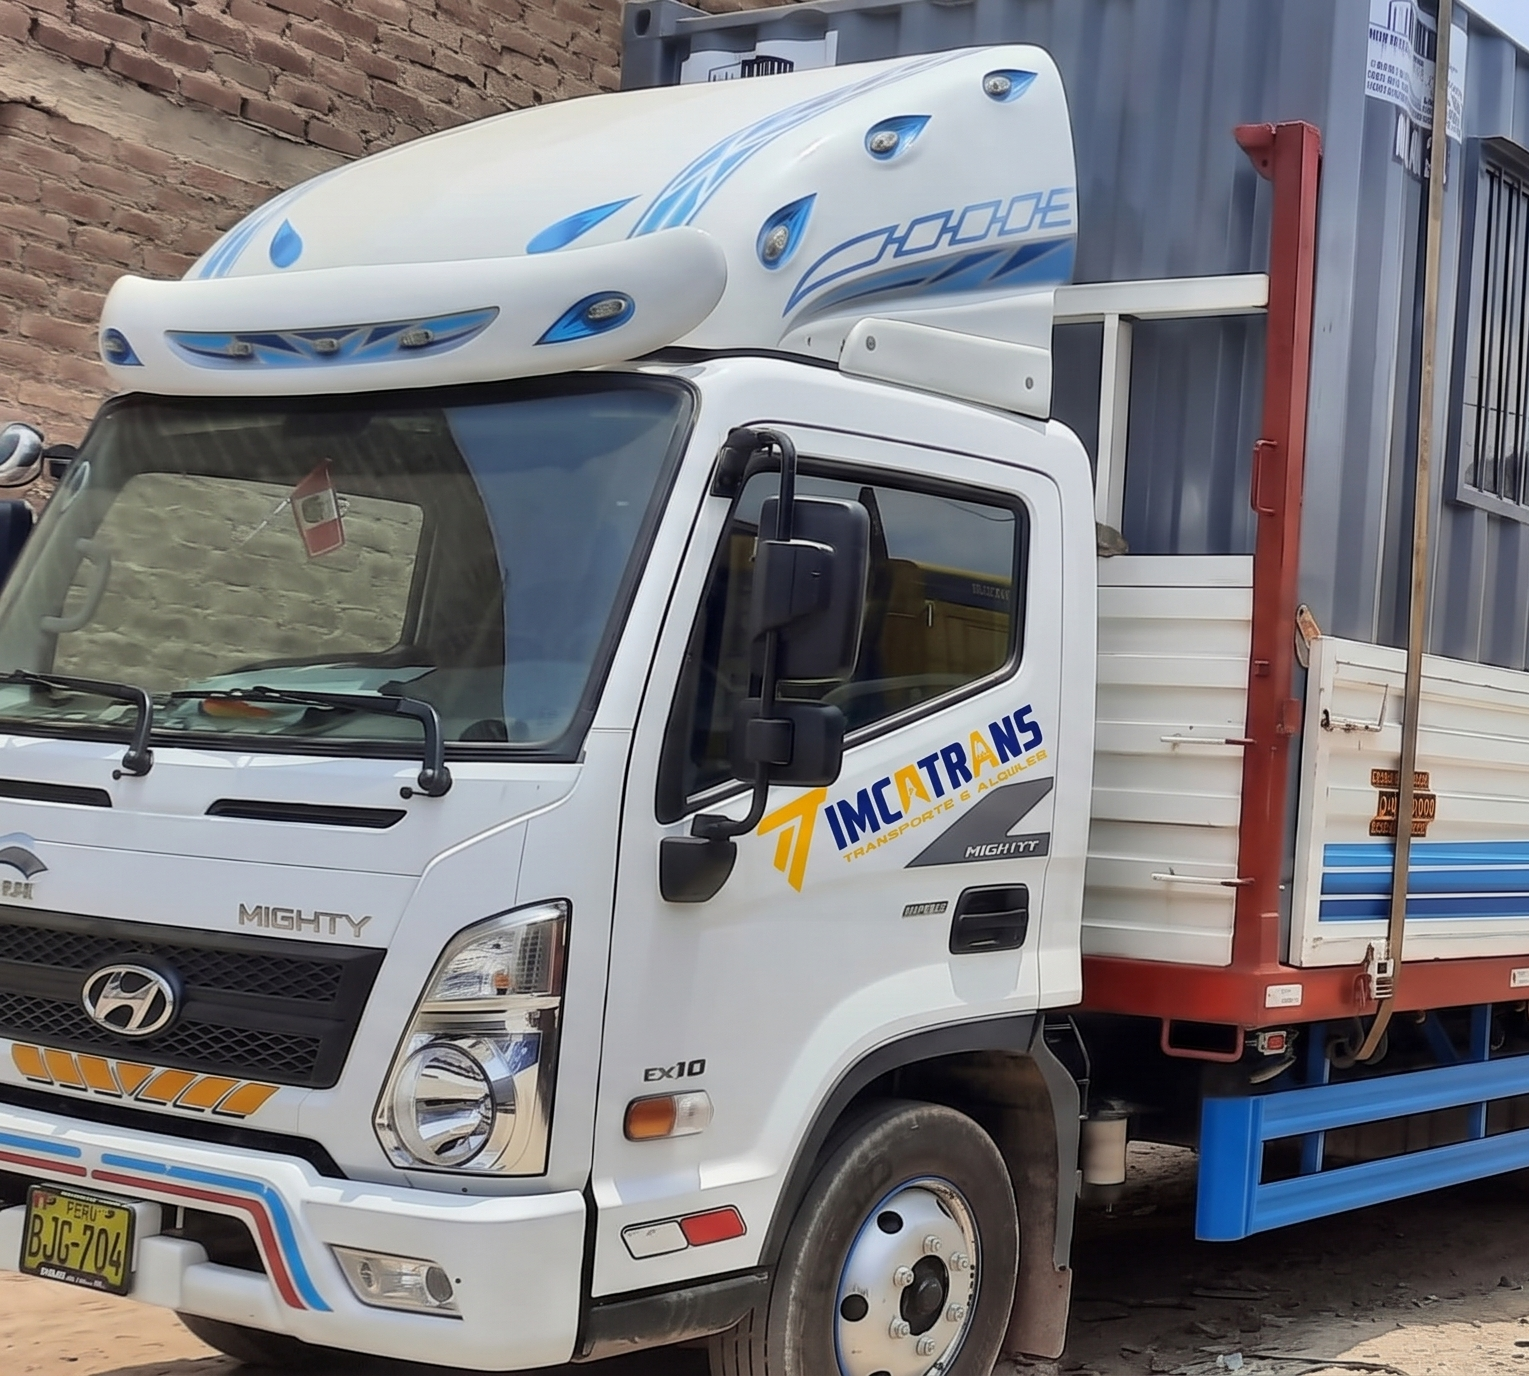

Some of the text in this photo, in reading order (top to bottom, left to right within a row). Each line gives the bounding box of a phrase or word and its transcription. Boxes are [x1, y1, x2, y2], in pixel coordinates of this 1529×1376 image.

[824, 704, 1043, 850] IMCATRANS
[843, 798, 955, 863] TRANSPORTE
[238, 903, 373, 938] MIGHTY
[643, 1058, 707, 1083] EX10
[27, 1213, 122, 1277] BJG-704
